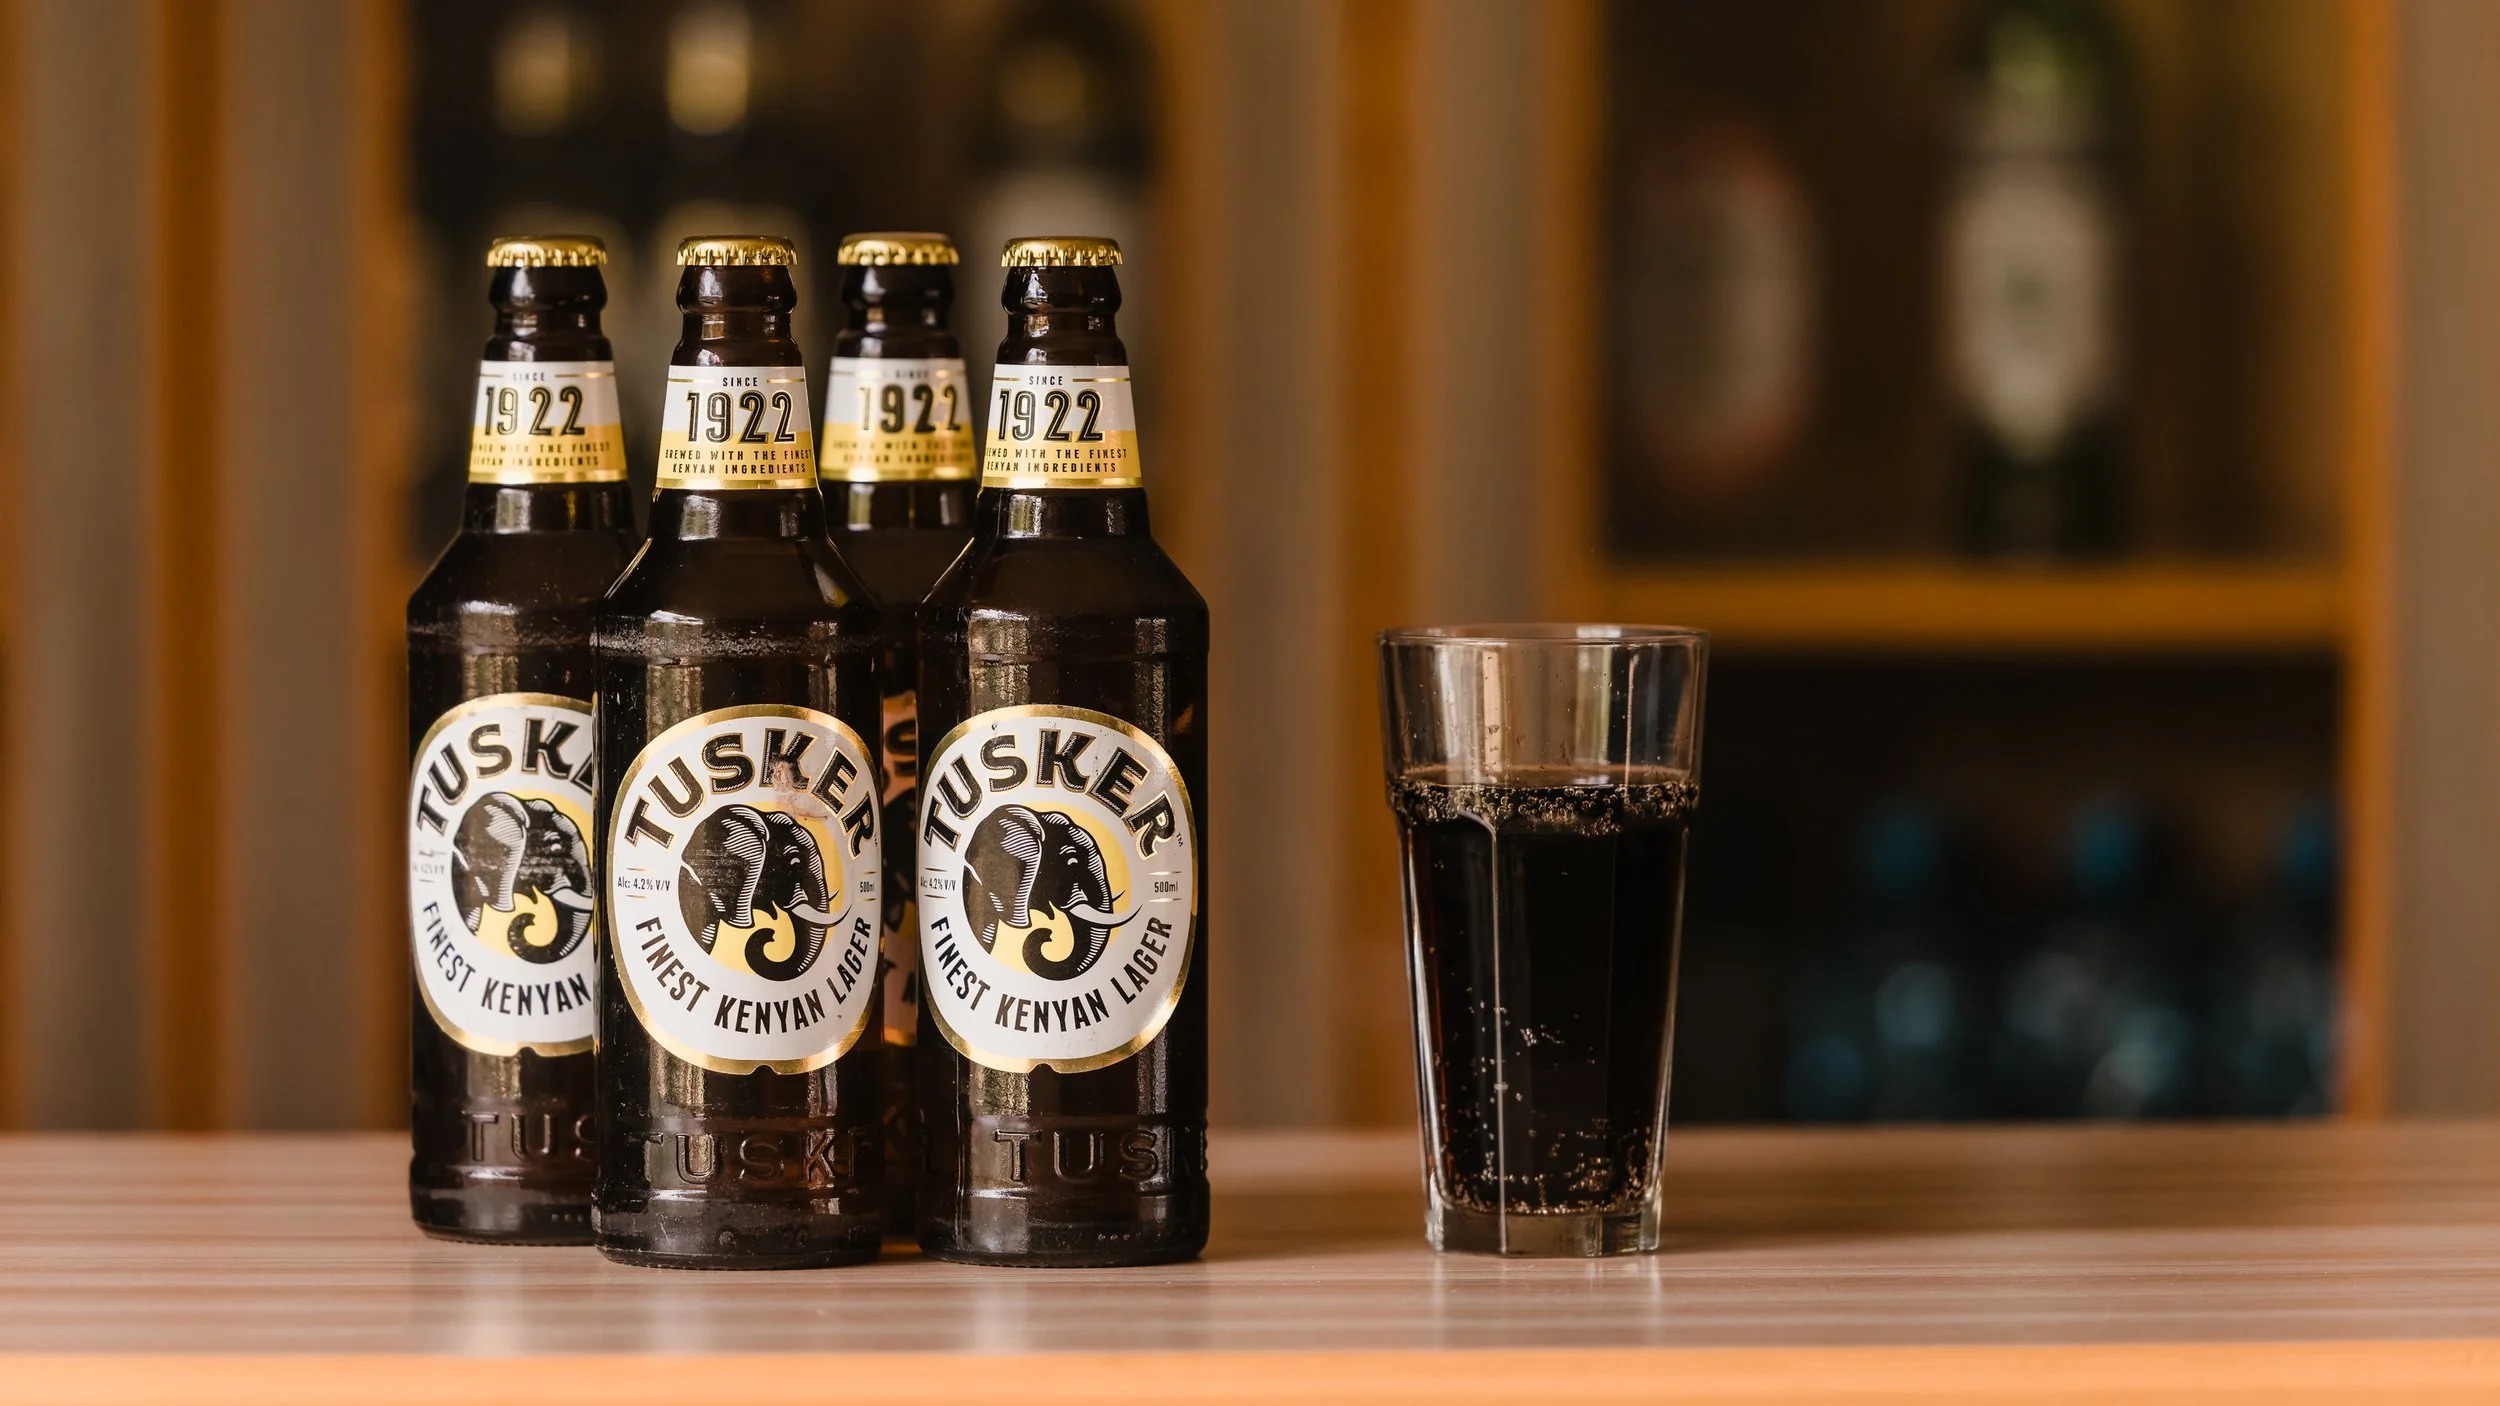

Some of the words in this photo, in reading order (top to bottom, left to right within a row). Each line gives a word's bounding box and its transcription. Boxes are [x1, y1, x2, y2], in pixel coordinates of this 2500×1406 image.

[722, 377, 759, 387] SINCE
[1028, 376, 1064, 386] SINCE
[484, 385, 587, 436] 1922
[687, 389, 797, 443] 1922
[858, 383, 961, 433] 1922
[998, 388, 1104, 443] 1922
[540, 443, 562, 453] THE
[664, 449, 701, 460] BREWED
[710, 450, 743, 460] WITH
[753, 450, 776, 460] THE
[784, 448, 812, 460] FINEST
[1015, 448, 1046, 459] WITH
[1056, 448, 1080, 459] THE
[1089, 448, 1127, 459] FINEST
[672, 463, 715, 474] KENYAN
[725, 463, 806, 475] INGREDIENTS
[1027, 462, 1116, 473] INGREDIENTS
[624, 728, 876, 861] TUSKER
[924, 728, 1177, 861] TUSKER
[633, 878, 653, 891] 4.2%
[655, 879, 671, 891] V/V
[1153, 880, 1179, 893] 500ml
[422, 901, 476, 993] FINEST
[481, 973, 592, 1016] KENYAN
[636, 916, 710, 1013] FINEST
[714, 988, 826, 1035] KENYAN
[826, 916, 872, 1005] LAGER
[931, 916, 990, 1011] FINEST
[995, 988, 1110, 1033] KENYAN
[1110, 916, 1173, 1004] LAGER
